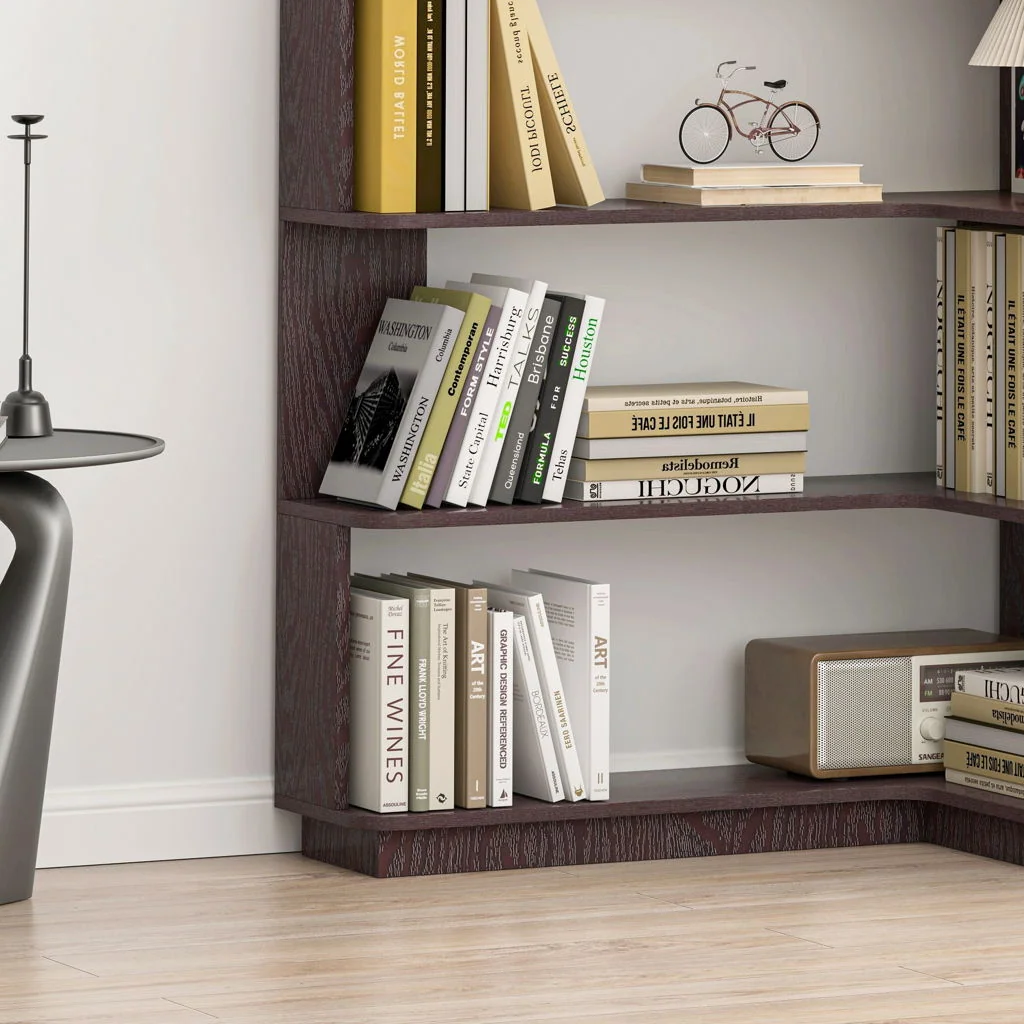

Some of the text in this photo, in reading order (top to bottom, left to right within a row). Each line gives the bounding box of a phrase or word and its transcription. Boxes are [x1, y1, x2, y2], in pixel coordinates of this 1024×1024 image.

[378, 320, 432, 340] WASHINGTON
[1008, 300, 1015, 310] IL
[1008, 313, 1017, 346] ÉTAIT
[458, 306, 523, 489] State Capital Harrisburg
[460, 326, 495, 417] FORM STYLE
[494, 307, 539, 442] TED TALKS
[552, 318, 598, 482] Tehas Houston
[392, 328, 453, 483] WASHINGTON Columbia
[410, 322, 479, 496] Italia Contemporan
[504, 315, 554, 490] Queensland Brisbane
[533, 316, 577, 485] FORMULA FOR SUCCESS
[1008, 403, 1015, 417] LE
[1008, 419, 1017, 449] CAFÉ
[387, 630, 404, 686] FINE
[470, 641, 484, 675] ART
[500, 629, 508, 670] GRAPHIC
[594, 636, 608, 668] ART
[419, 658, 427, 740] FRANK LLOYD WRIGHT
[500, 673, 508, 706] DESIGN
[532, 690, 549, 738] BORDEAUX
[386, 698, 403, 783] WINES
[554, 691, 573, 749] EERO SAARINEN
